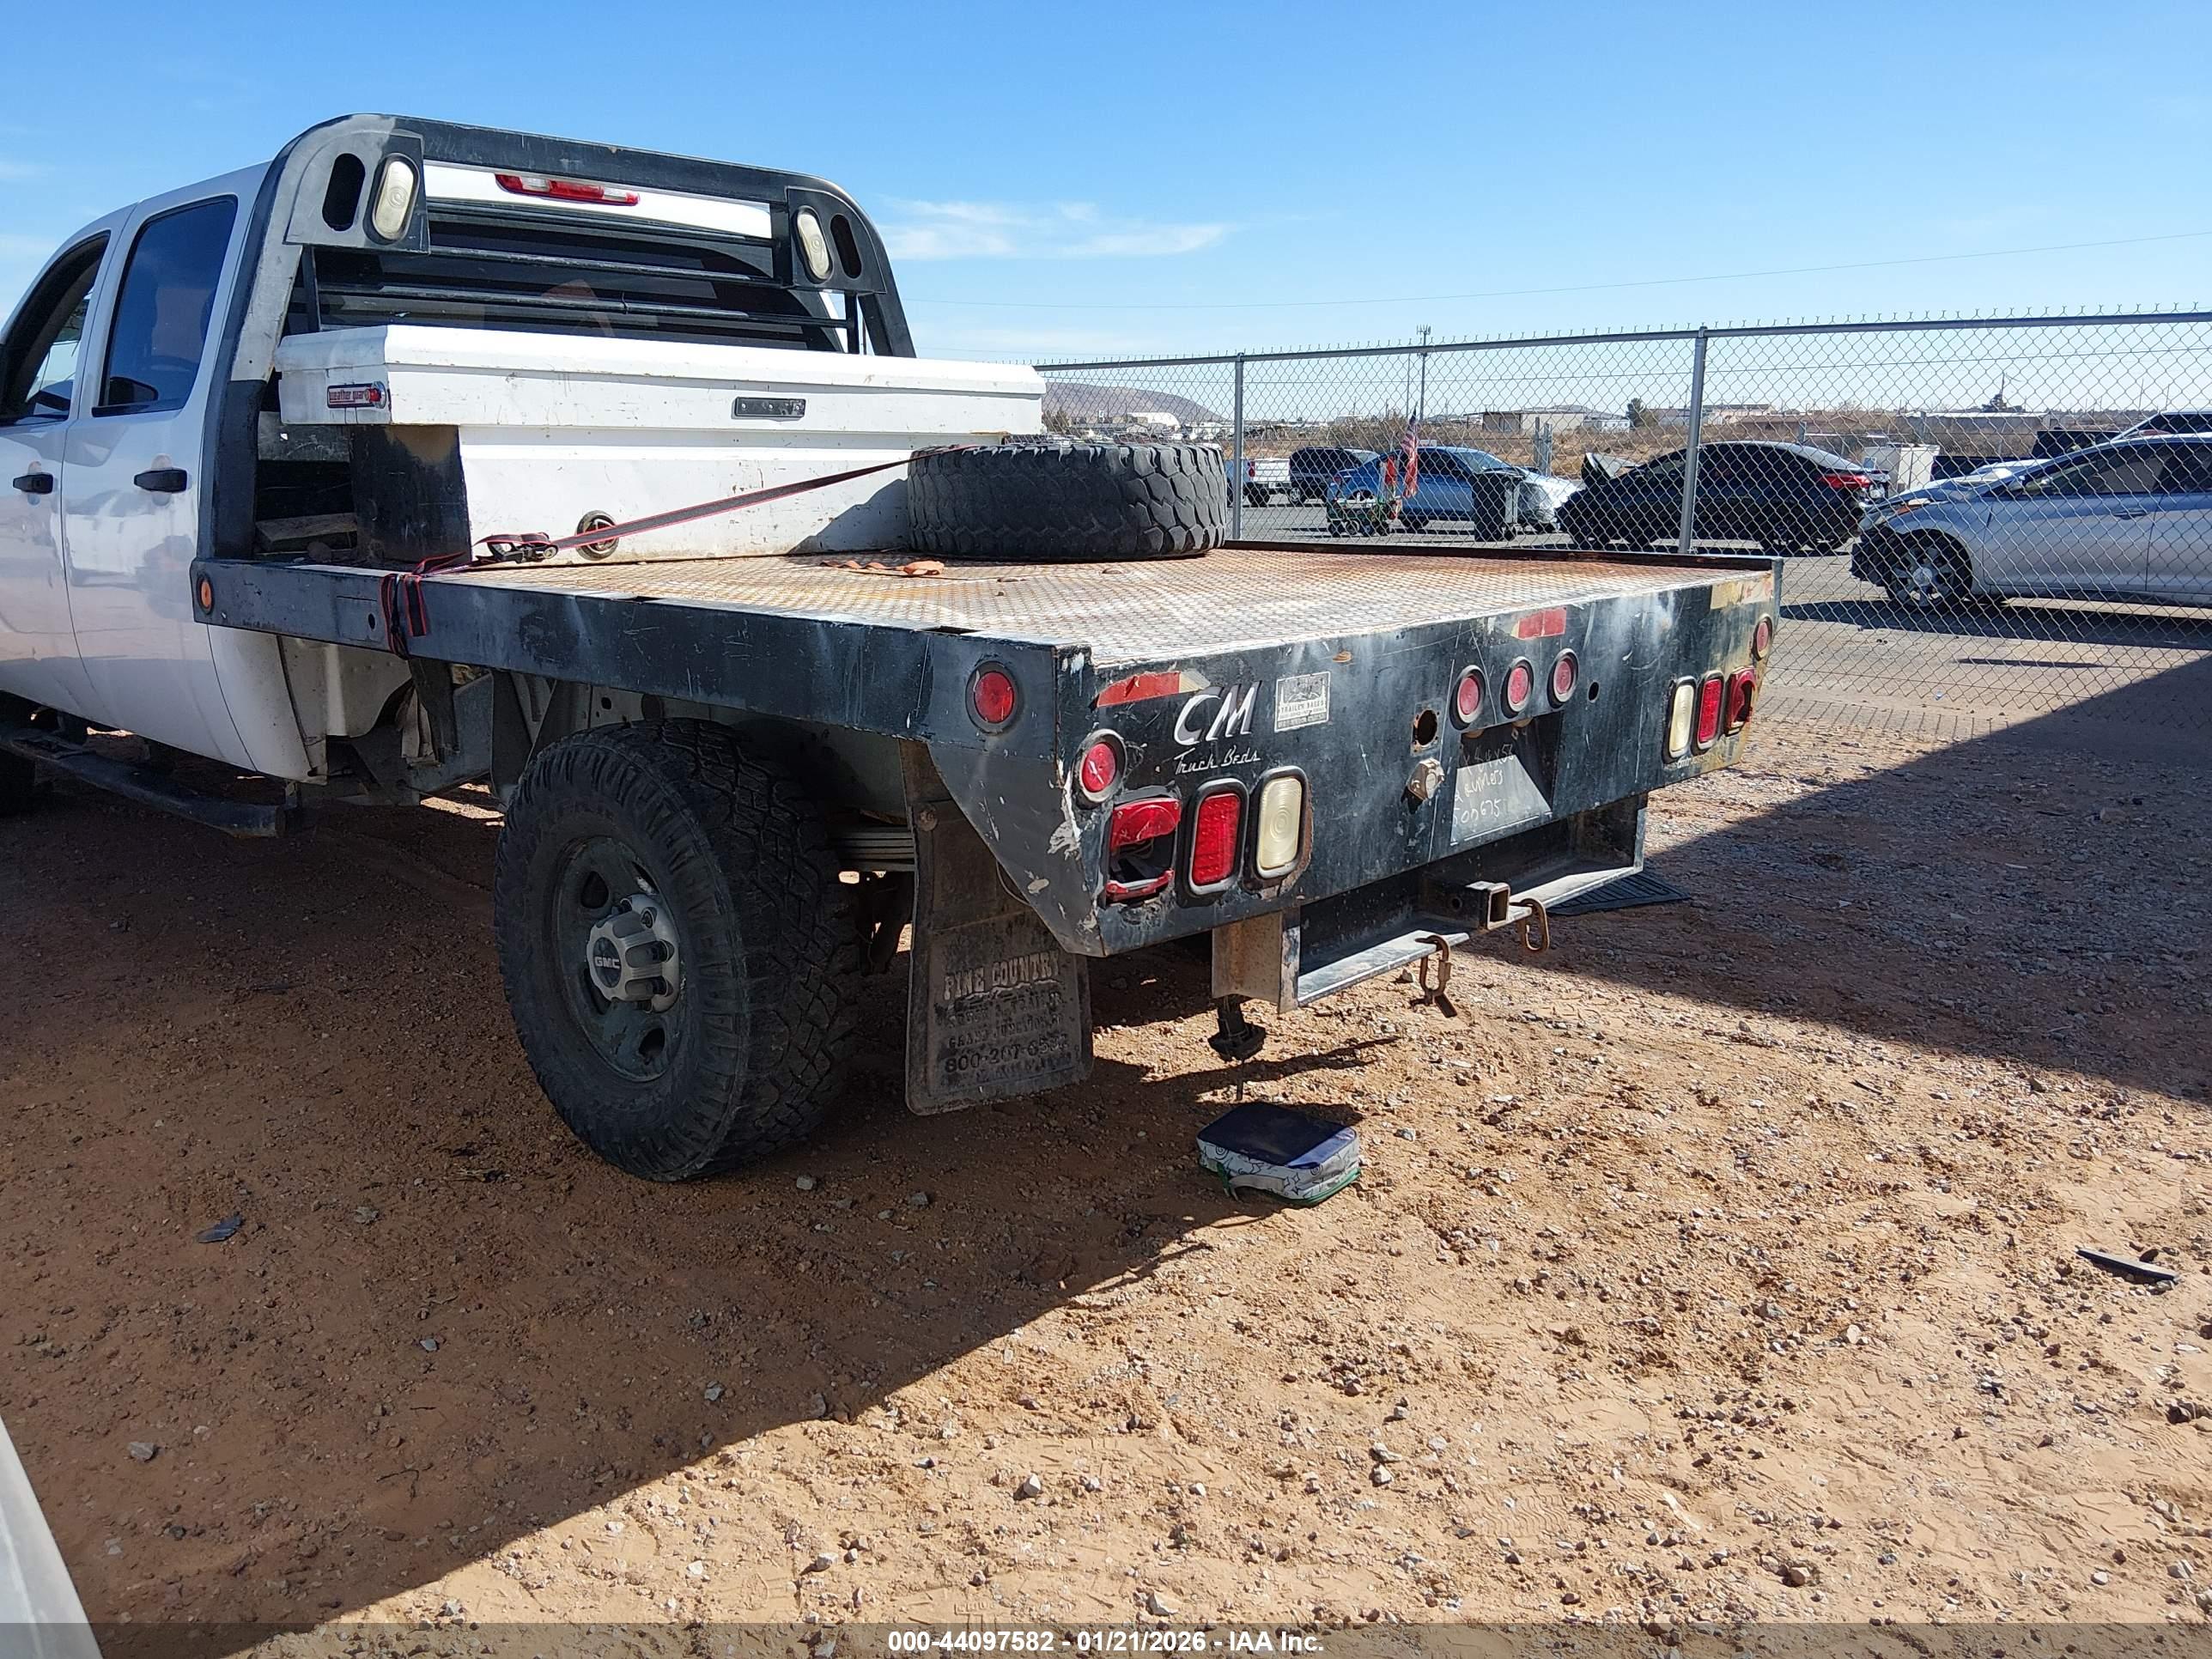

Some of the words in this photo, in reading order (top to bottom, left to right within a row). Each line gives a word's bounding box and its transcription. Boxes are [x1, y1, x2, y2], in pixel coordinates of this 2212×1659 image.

[1174, 680, 1262, 745] CM
[1174, 748, 1218, 775] Truck
[1221, 745, 1261, 767] Beds
[594, 957, 620, 969] GMC
[944, 967, 985, 1000] PINE
[991, 950, 1060, 987] COUNTRY
